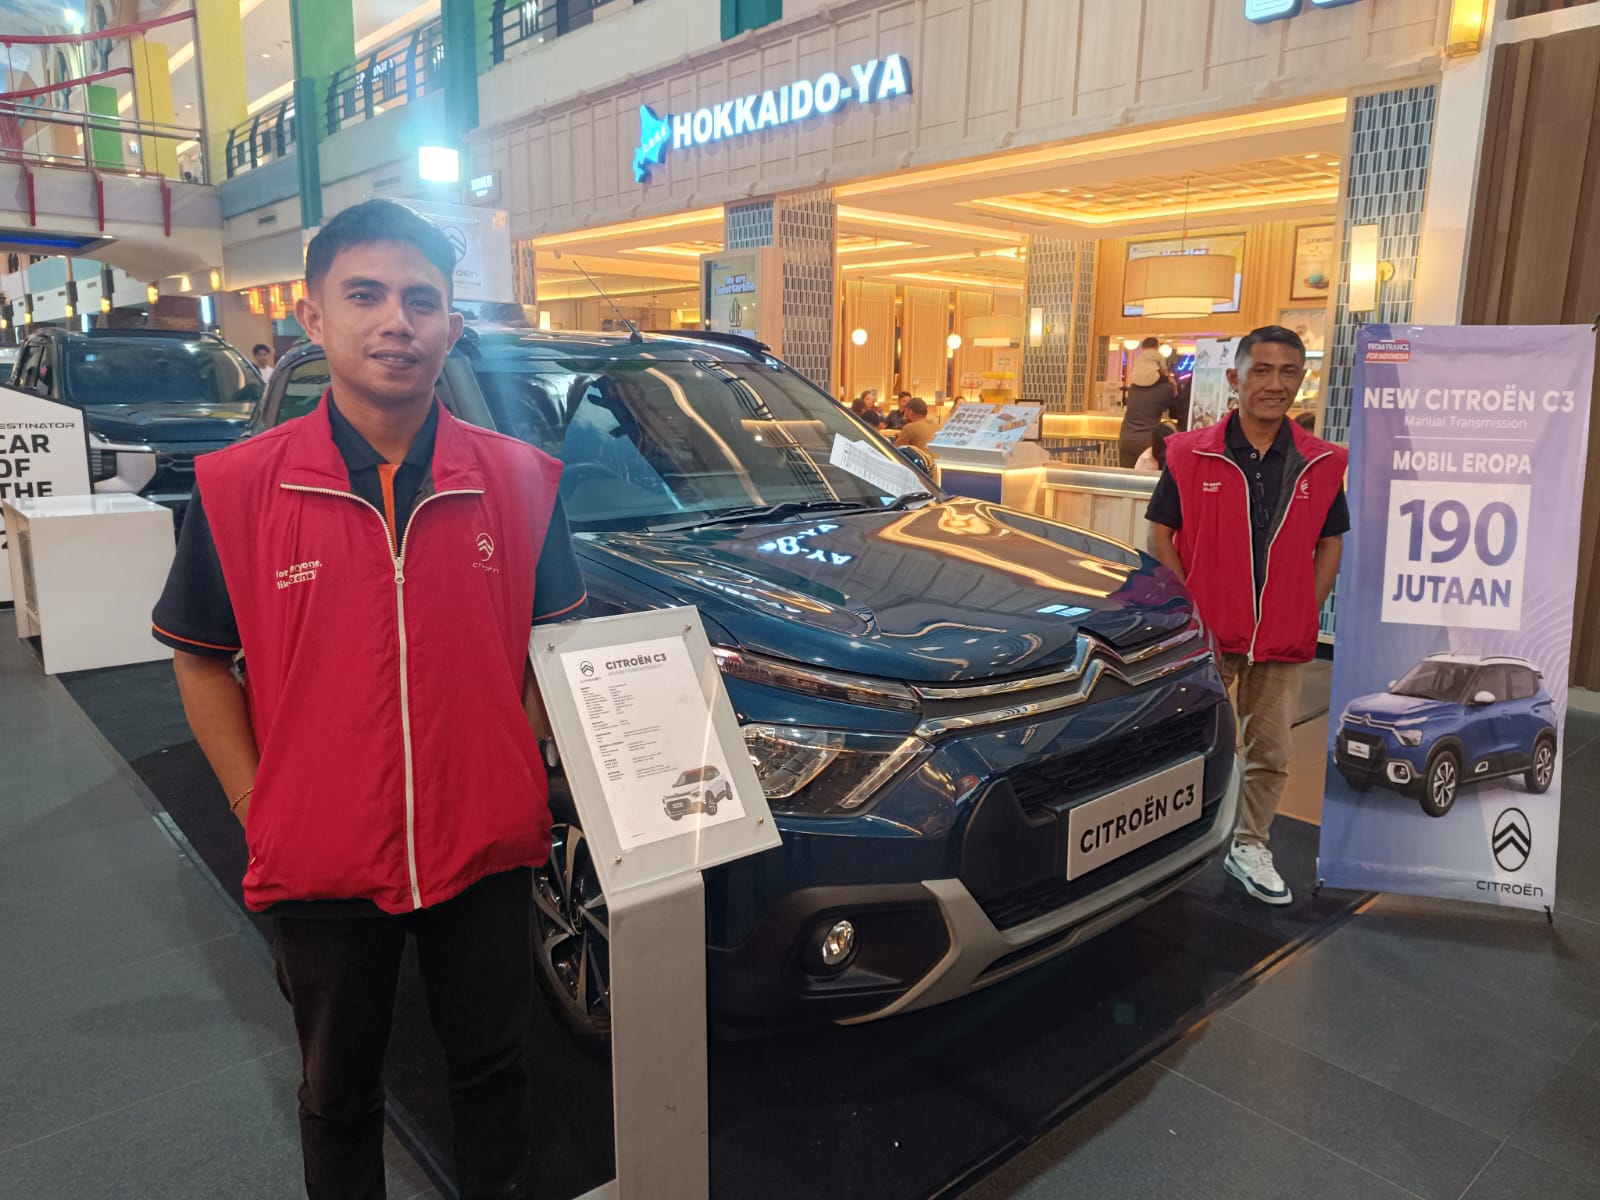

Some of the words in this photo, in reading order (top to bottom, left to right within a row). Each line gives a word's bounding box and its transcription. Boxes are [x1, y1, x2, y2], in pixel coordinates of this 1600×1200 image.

[672, 52, 908, 150] HOKKAIDO-YA
[1367, 343, 1385, 351] FROM
[1385, 343, 1409, 351] FRANCE
[1363, 386, 1420, 410] NEW
[1424, 384, 1534, 412] CITROËN
[1542, 390, 1575, 413] C3
[1404, 415, 1446, 428] Manual
[1448, 416, 1528, 430] Transmission
[1392, 450, 1458, 472] MOBIL
[1462, 452, 1532, 475] EROPA
[1399, 499, 1518, 566] 190
[1392, 573, 1512, 608] JUTAAN
[605, 653, 652, 670] CITROËN
[653, 653, 667, 663] C3
[1080, 795, 1168, 853] CITROËN
[1172, 783, 1195, 811] C3
[1476, 880, 1543, 898] CITROËN
